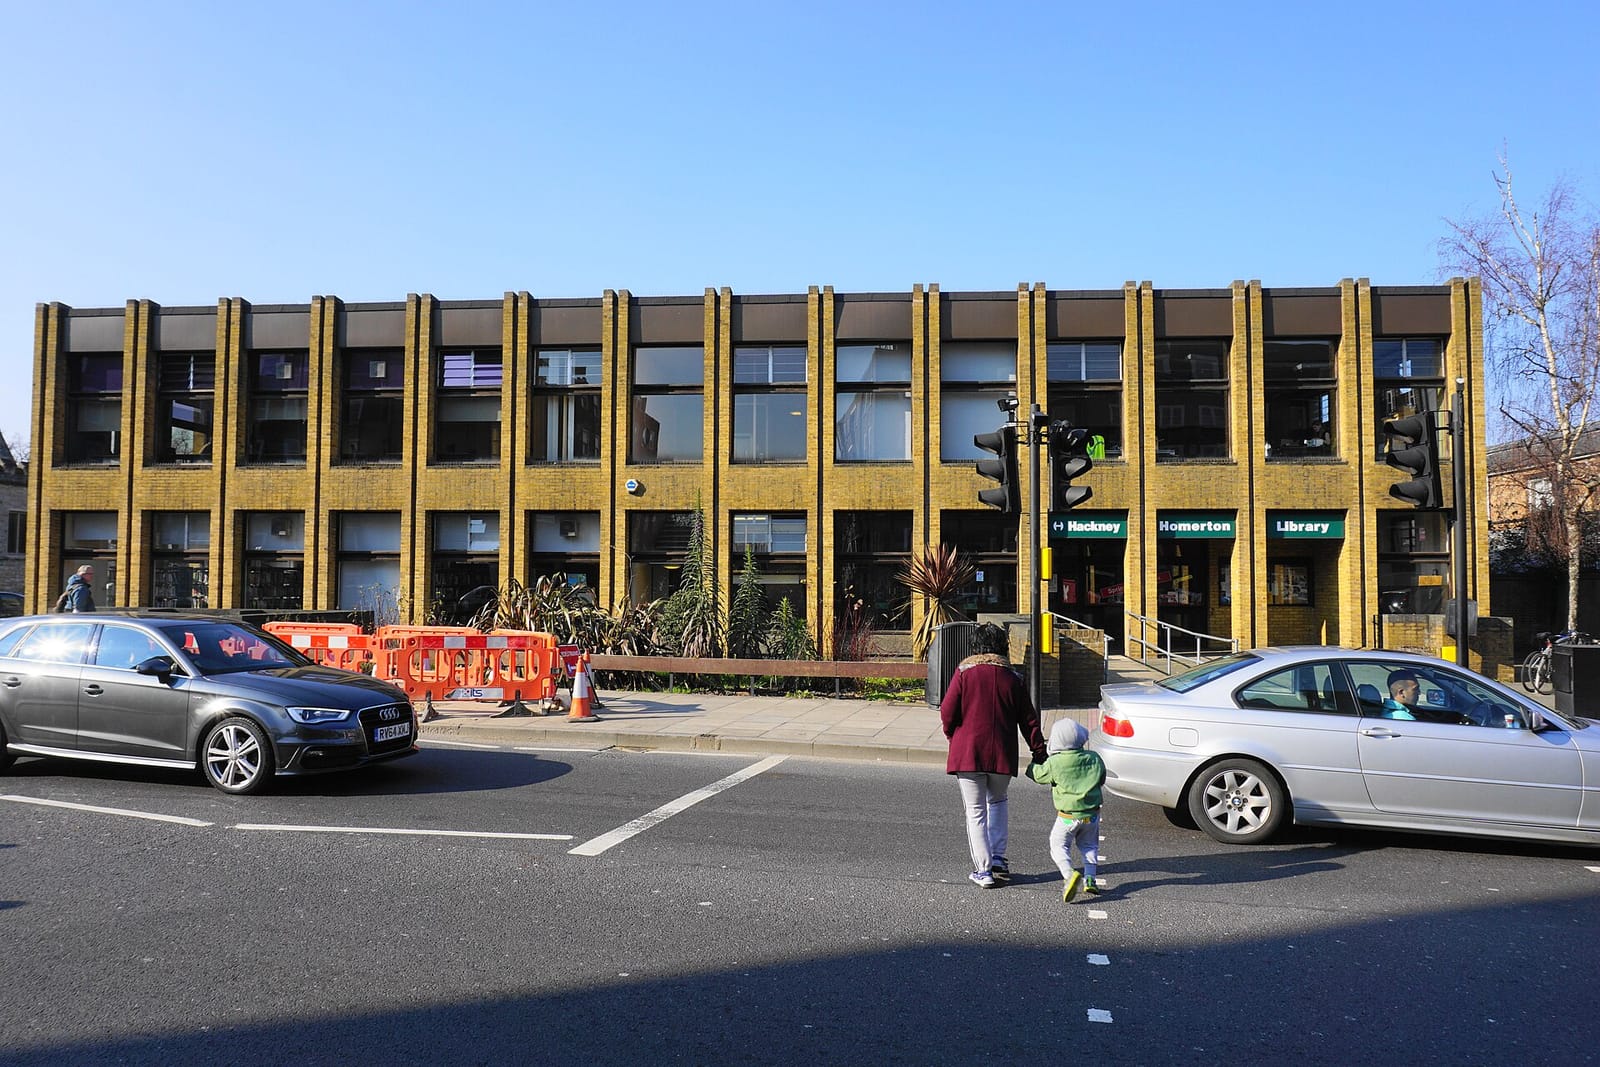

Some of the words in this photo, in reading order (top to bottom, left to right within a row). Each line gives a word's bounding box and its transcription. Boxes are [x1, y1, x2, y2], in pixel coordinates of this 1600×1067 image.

[1067, 520, 1120, 534] Hackney
[1159, 520, 1231, 532] Homerton
[1276, 520, 1330, 534] Library
